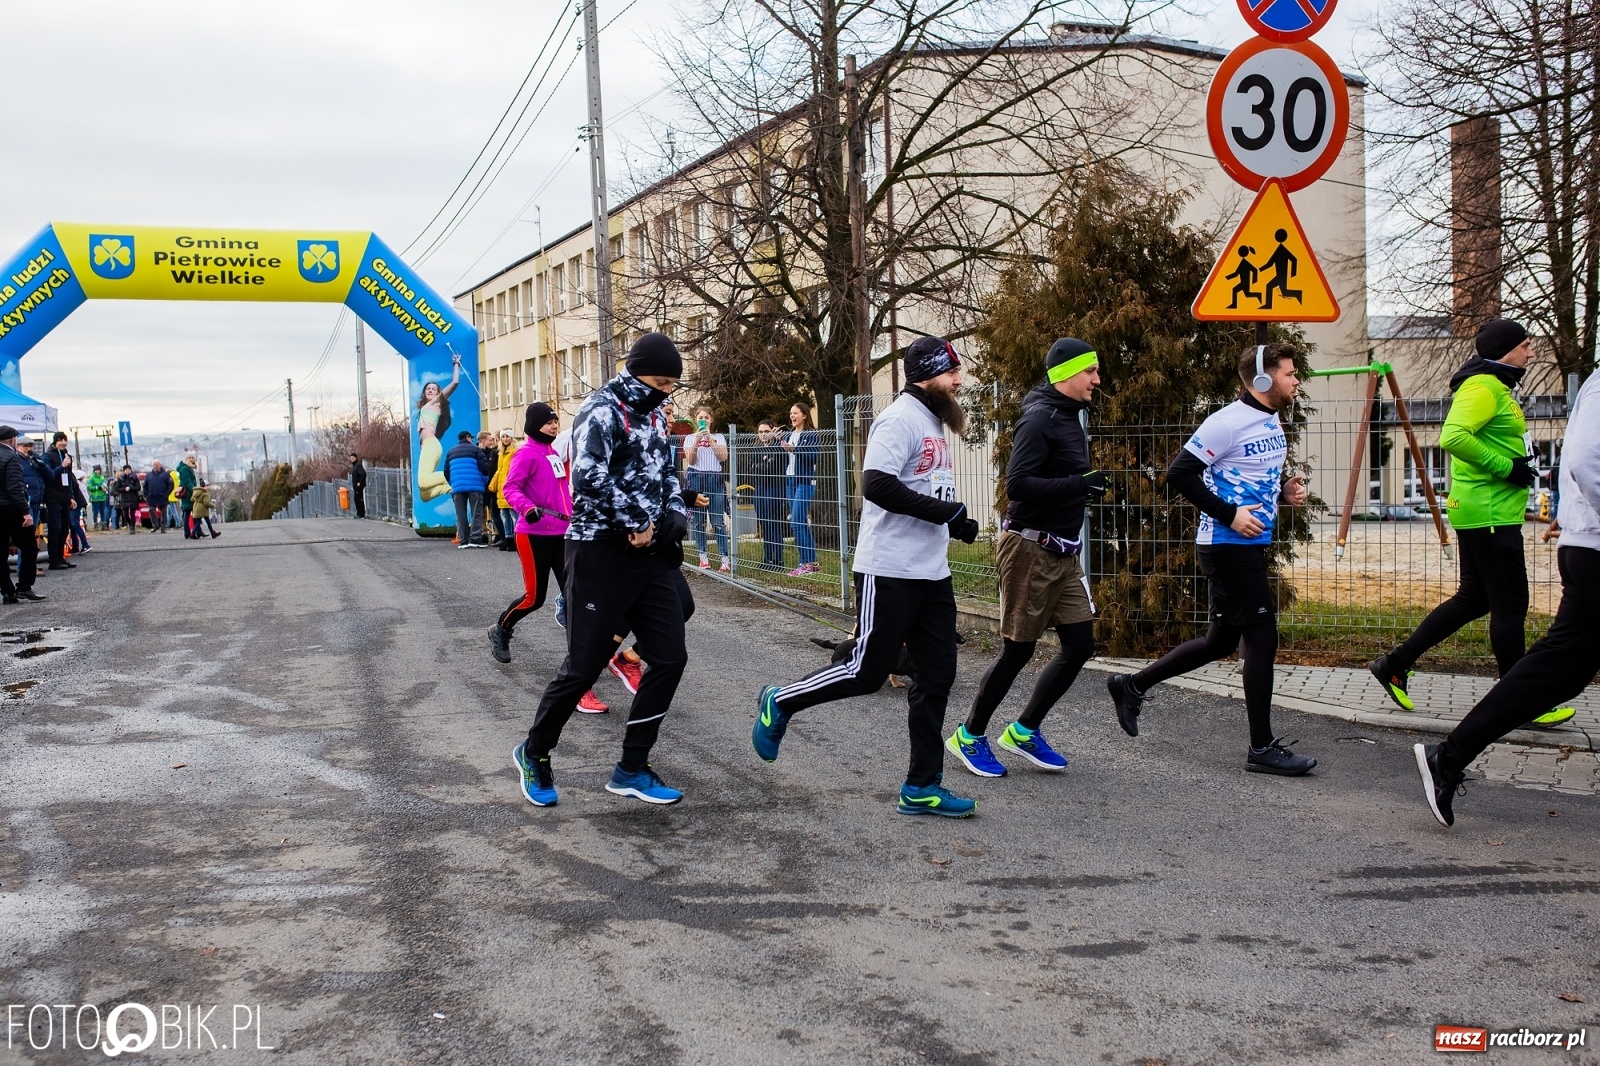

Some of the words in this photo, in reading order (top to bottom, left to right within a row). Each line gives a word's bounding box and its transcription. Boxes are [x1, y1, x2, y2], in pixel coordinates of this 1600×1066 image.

[1231, 74, 1327, 153] 30
[154, 251, 282, 268] Pietrowice
[175, 236, 259, 250] Gmina
[11, 248, 55, 287] ludzi
[171, 270, 265, 285] Wielkie
[359, 276, 436, 346] aktywnych
[372, 258, 415, 302] Gmina
[415, 297, 453, 334] ludzi
